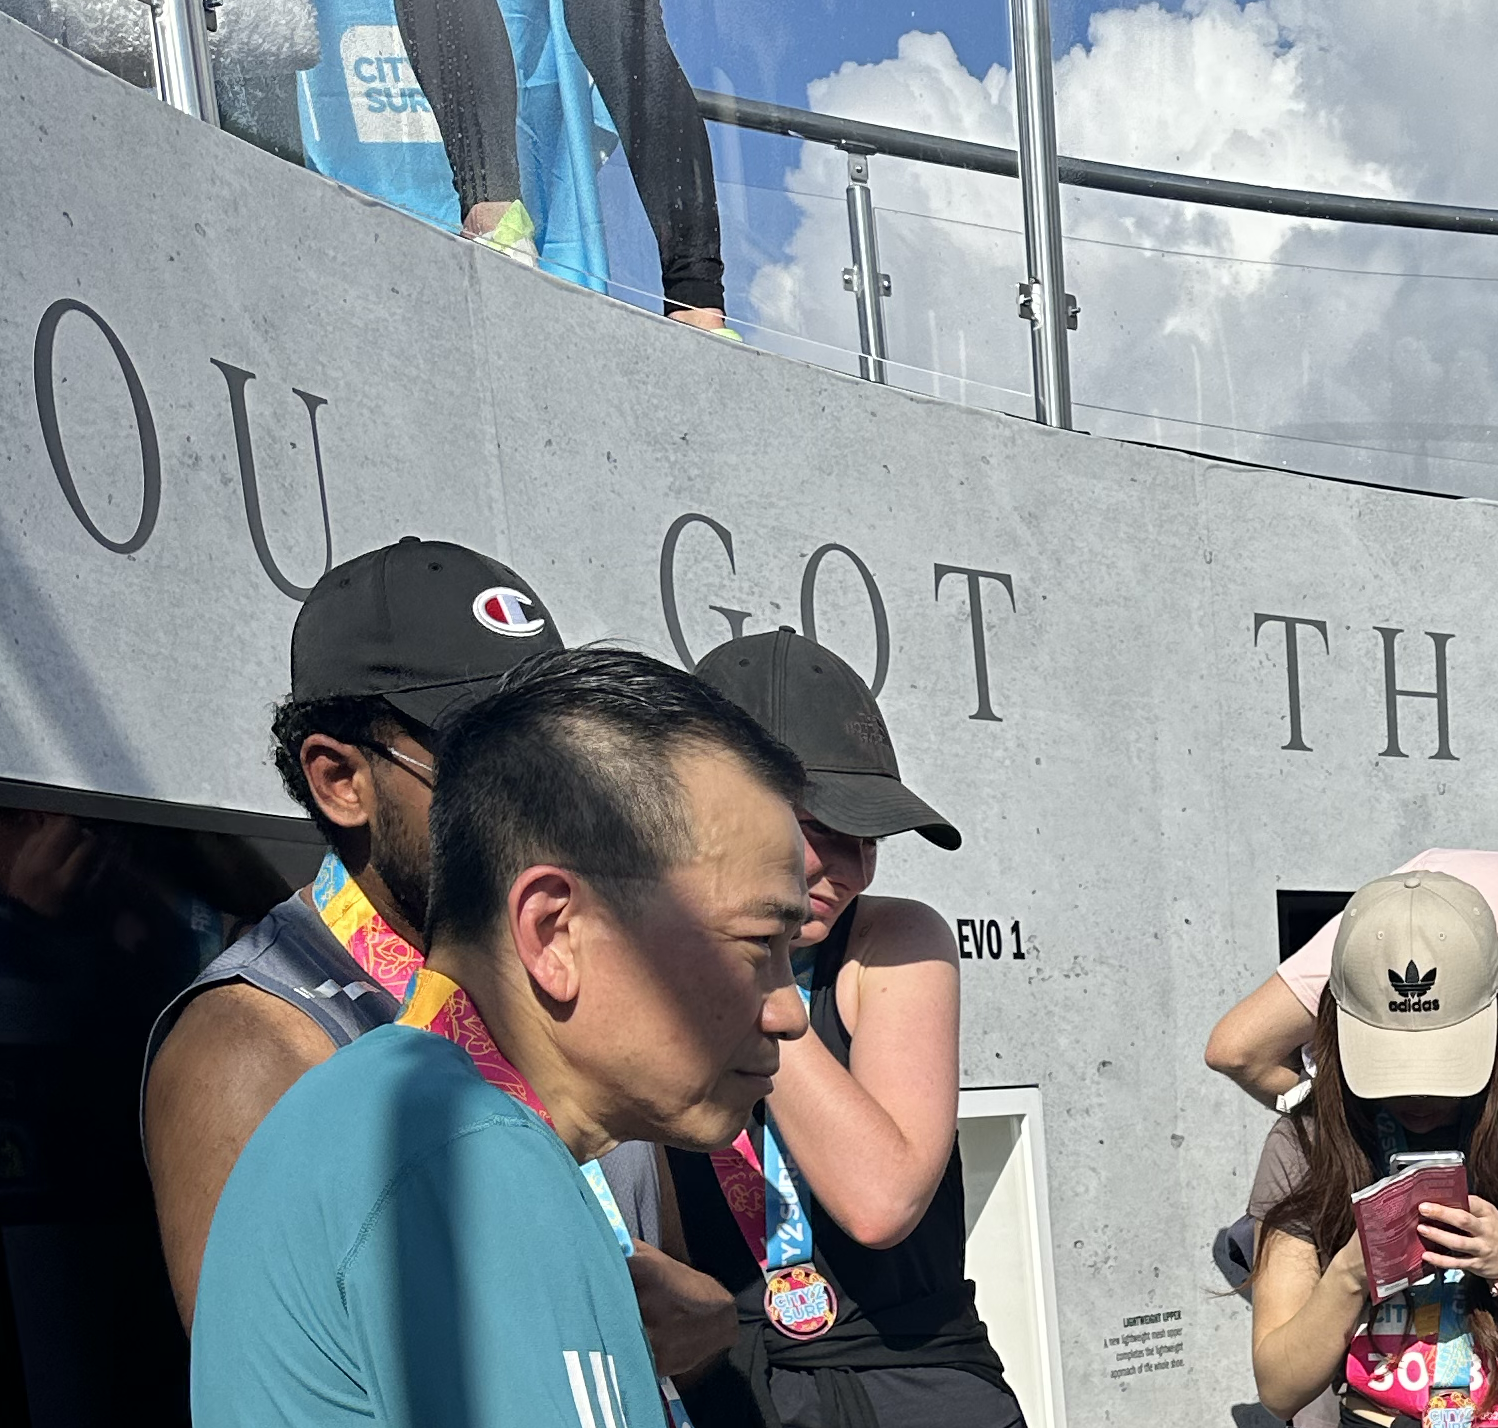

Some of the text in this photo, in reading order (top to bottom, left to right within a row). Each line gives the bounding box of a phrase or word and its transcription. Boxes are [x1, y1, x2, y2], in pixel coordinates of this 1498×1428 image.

[354, 56, 411, 84] CIT
[956, 918, 1026, 960] EVO 1
[1388, 998, 1440, 1013] adidas
[783, 1301, 825, 1323] SURF
